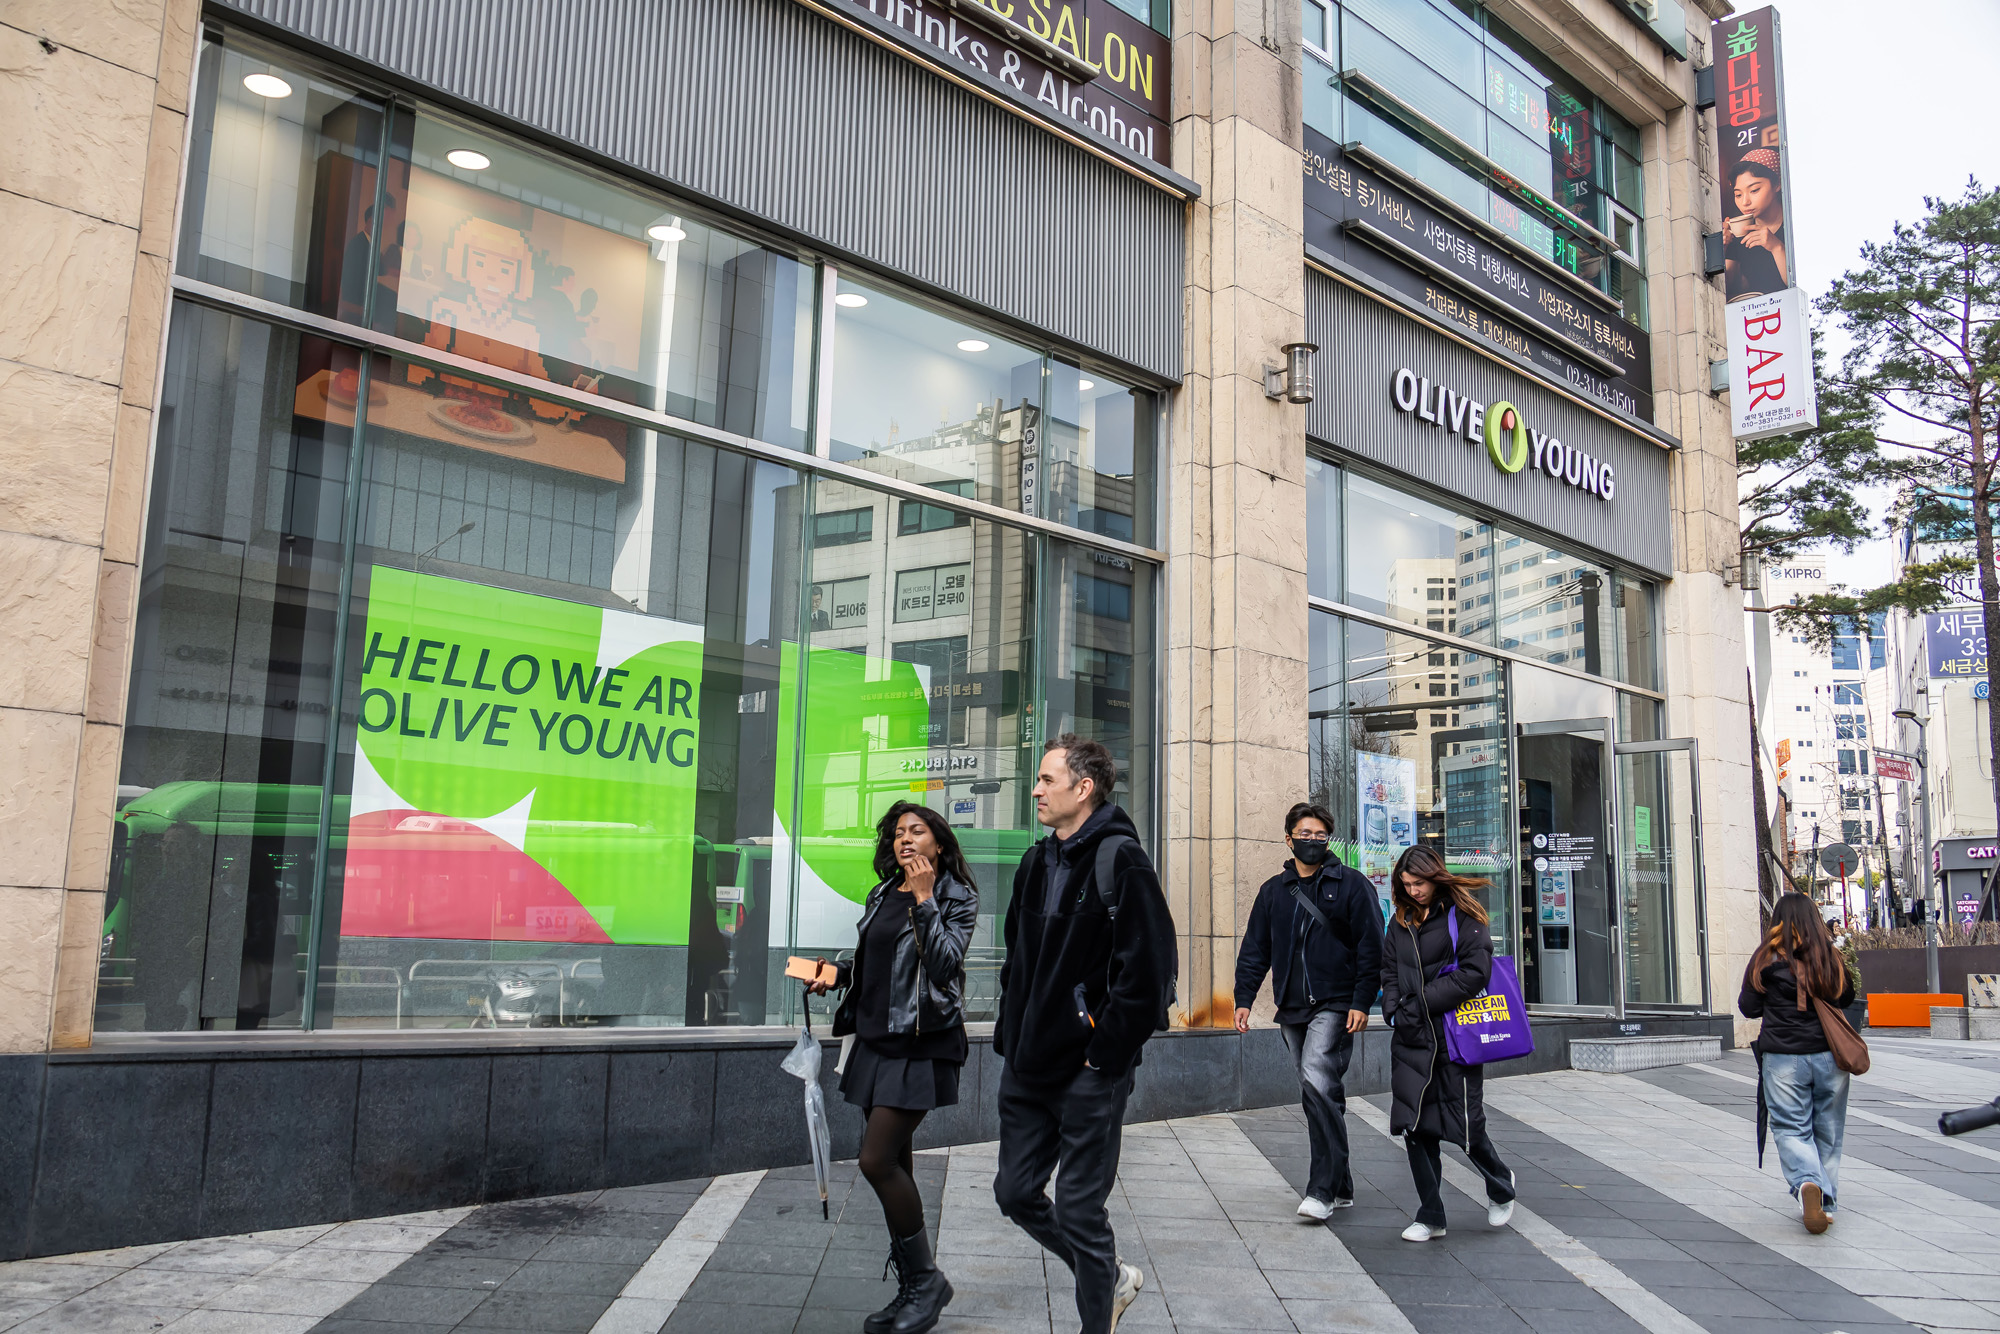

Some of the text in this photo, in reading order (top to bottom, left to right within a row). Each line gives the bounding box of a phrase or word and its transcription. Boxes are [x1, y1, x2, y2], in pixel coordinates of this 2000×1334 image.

[1027, 0, 1153, 101] SALON
[999, 50, 1025, 91] &
[1036, 70, 1154, 160] Alcohol
[1737, 126, 1758, 147] 2F
[1357, 179, 1416, 232] 등기서비스
[1424, 219, 1477, 271] 사업자등록
[1481, 254, 1530, 299] 대행서비스
[1538, 287, 1591, 337] 사업자주소지
[1594, 319, 1636, 360] 등록서비스
[1566, 364, 1637, 417] 02-3143-0501
[1743, 308, 1786, 411] BAR
[1391, 367, 1615, 501] OLIVE YOUNG
[1795, 408, 1806, 417] B1
[1784, 567, 1822, 579] KIPRO
[363, 631, 541, 695] HELLO
[551, 658, 630, 709] WE
[634, 675, 702, 720] AR
[358, 687, 696, 768] OLIVE YOUNG
[1967, 846, 1998, 858] CAT
[1456, 997, 1505, 1015] KOREAN
[1456, 1010, 1511, 1026] FAST&FUN
